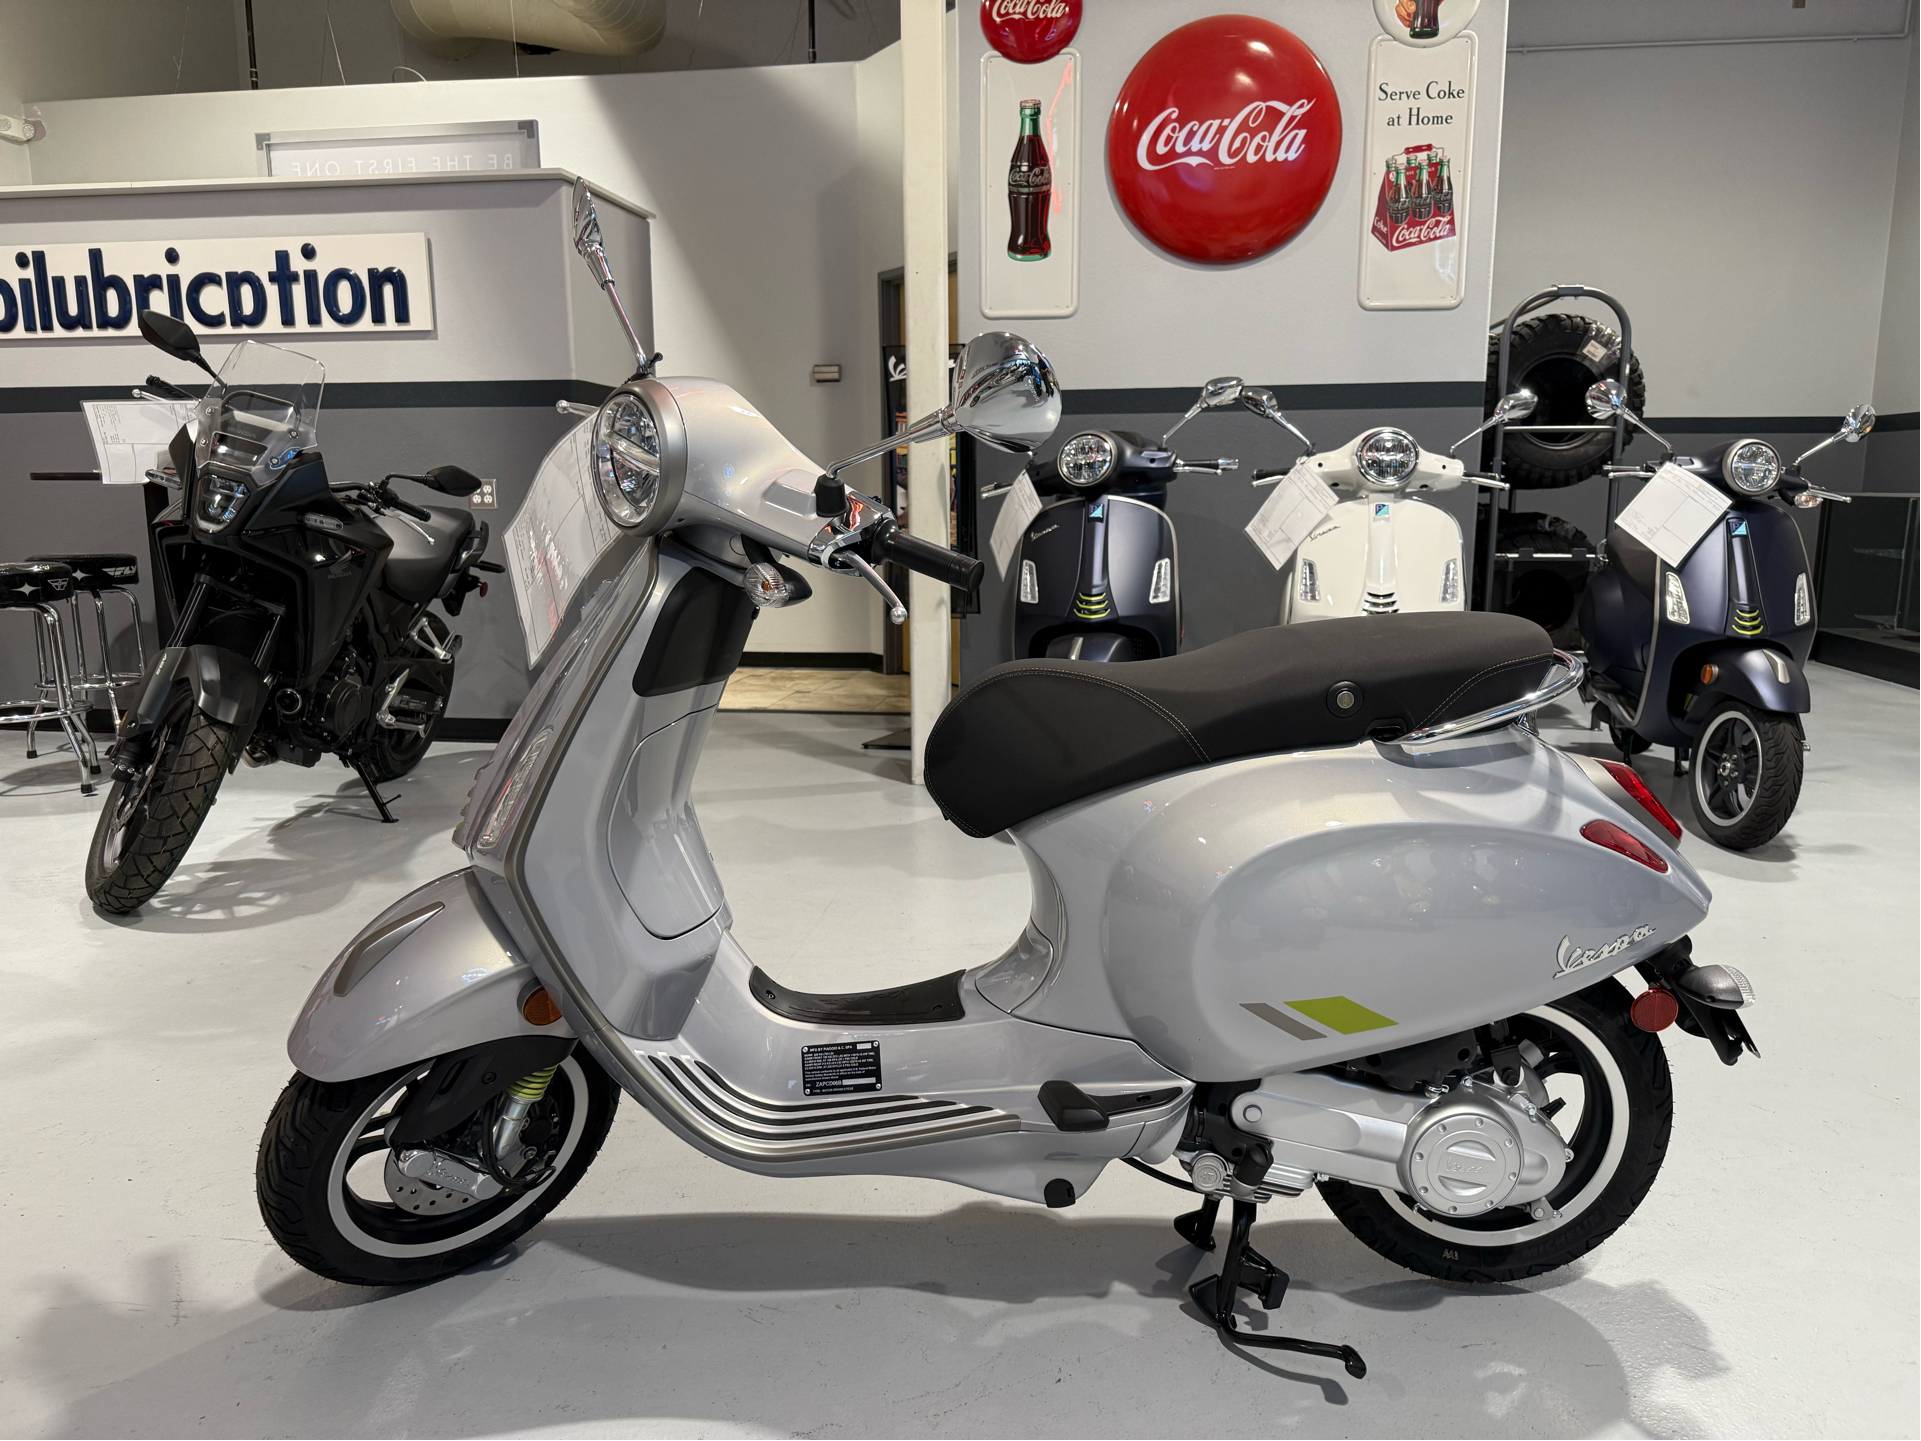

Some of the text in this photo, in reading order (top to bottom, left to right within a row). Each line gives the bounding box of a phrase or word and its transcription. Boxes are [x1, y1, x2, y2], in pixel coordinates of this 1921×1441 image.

[992, 0, 1067, 21] Coca-Cola
[1378, 80, 1465, 101] Serve Coke
[1386, 107, 1453, 127] at Home
[1136, 98, 1317, 171] Coca-Cola
[1392, 215, 1452, 247] Coca-Cola
[1552, 924, 1657, 979] Vespa
